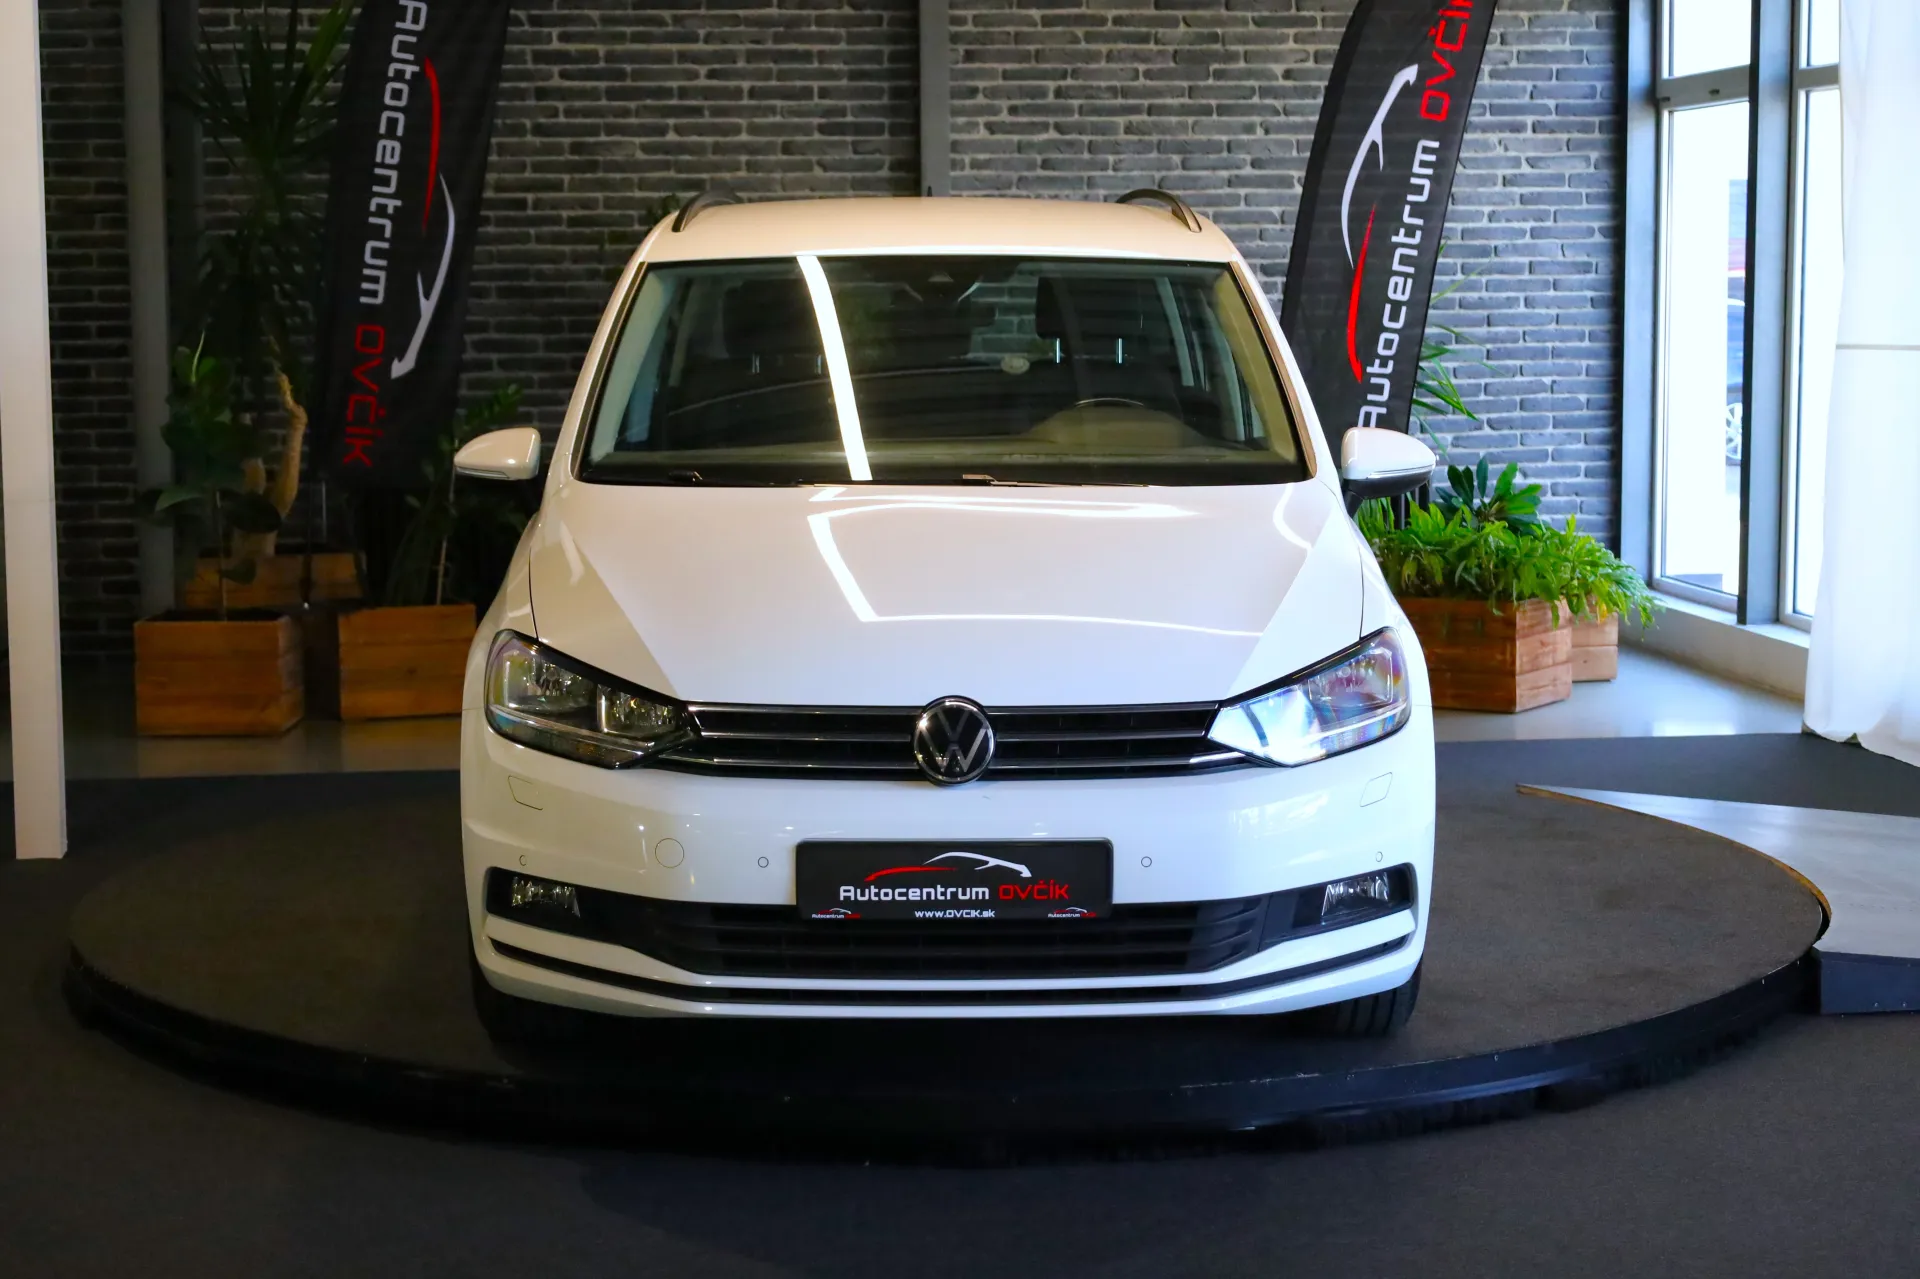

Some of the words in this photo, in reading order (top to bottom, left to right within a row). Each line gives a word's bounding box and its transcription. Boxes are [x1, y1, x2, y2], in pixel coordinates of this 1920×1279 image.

[360, 0, 427, 305] Autocentrum
[1357, 139, 1440, 428] Autocentrum
[839, 885, 990, 901] Autocentrum
